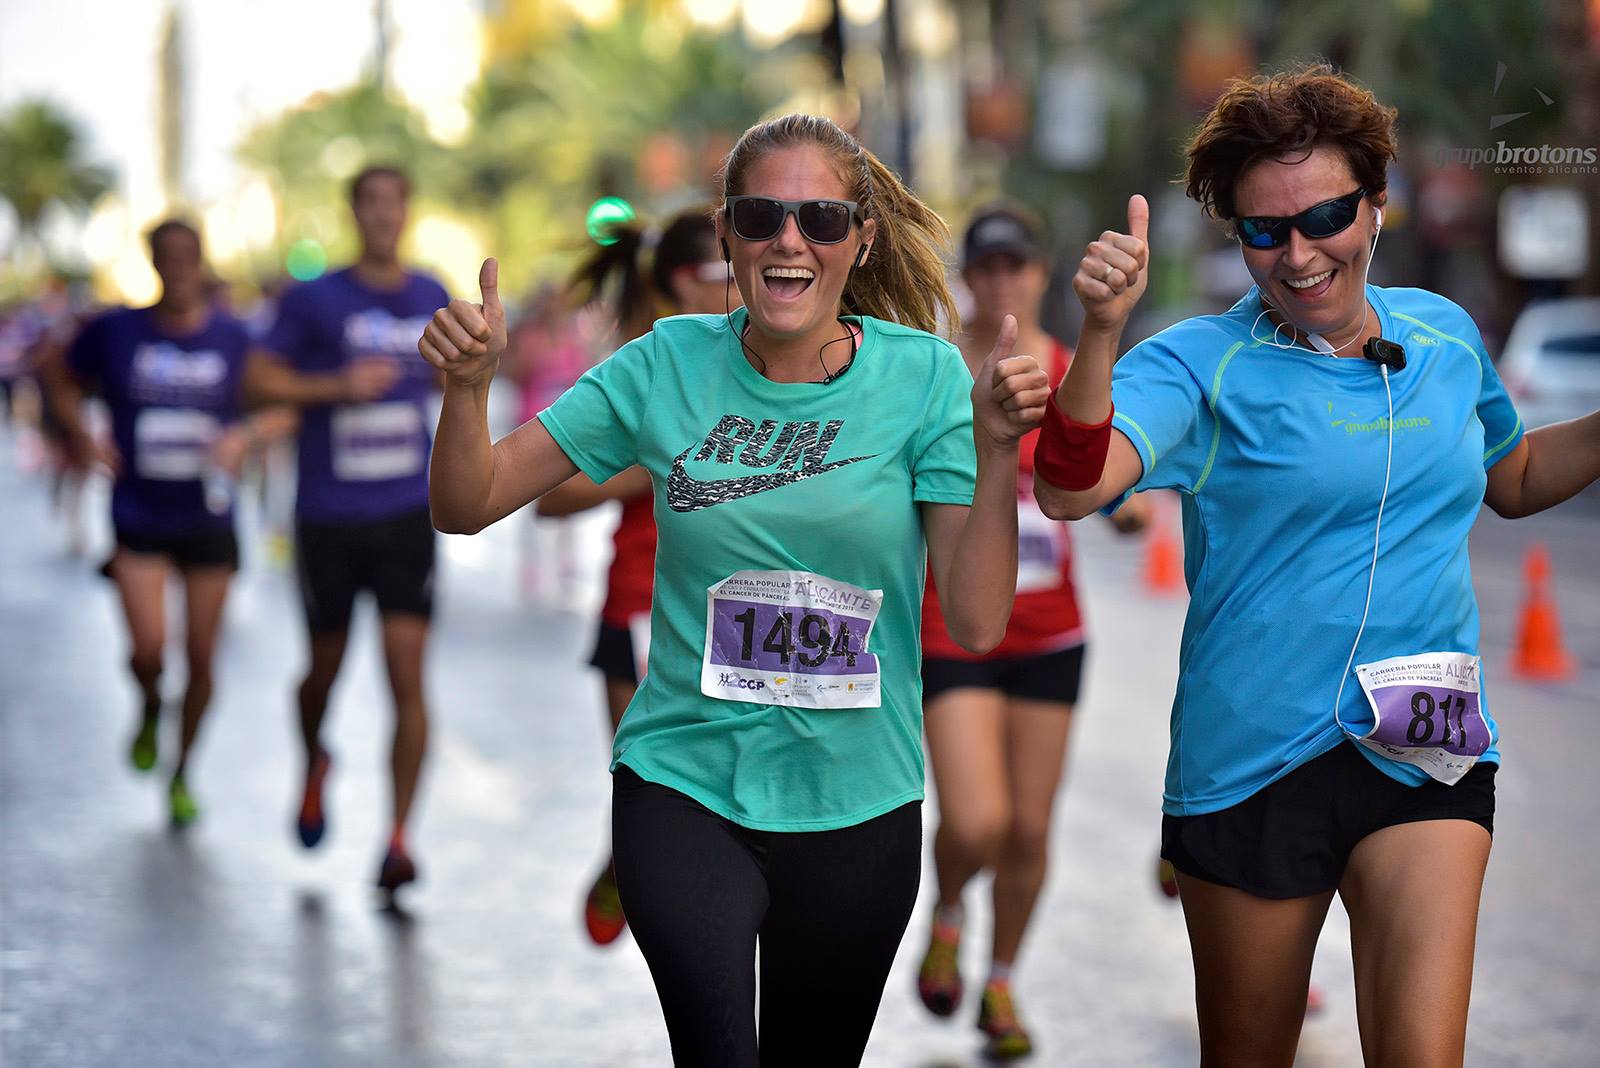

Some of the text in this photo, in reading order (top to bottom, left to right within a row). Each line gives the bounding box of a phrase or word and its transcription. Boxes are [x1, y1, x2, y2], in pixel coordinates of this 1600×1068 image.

[694, 414, 846, 472] RUN
[734, 607, 858, 668] 1494
[1369, 665, 1406, 677] CARRERA
[1406, 691, 1467, 748] 817
